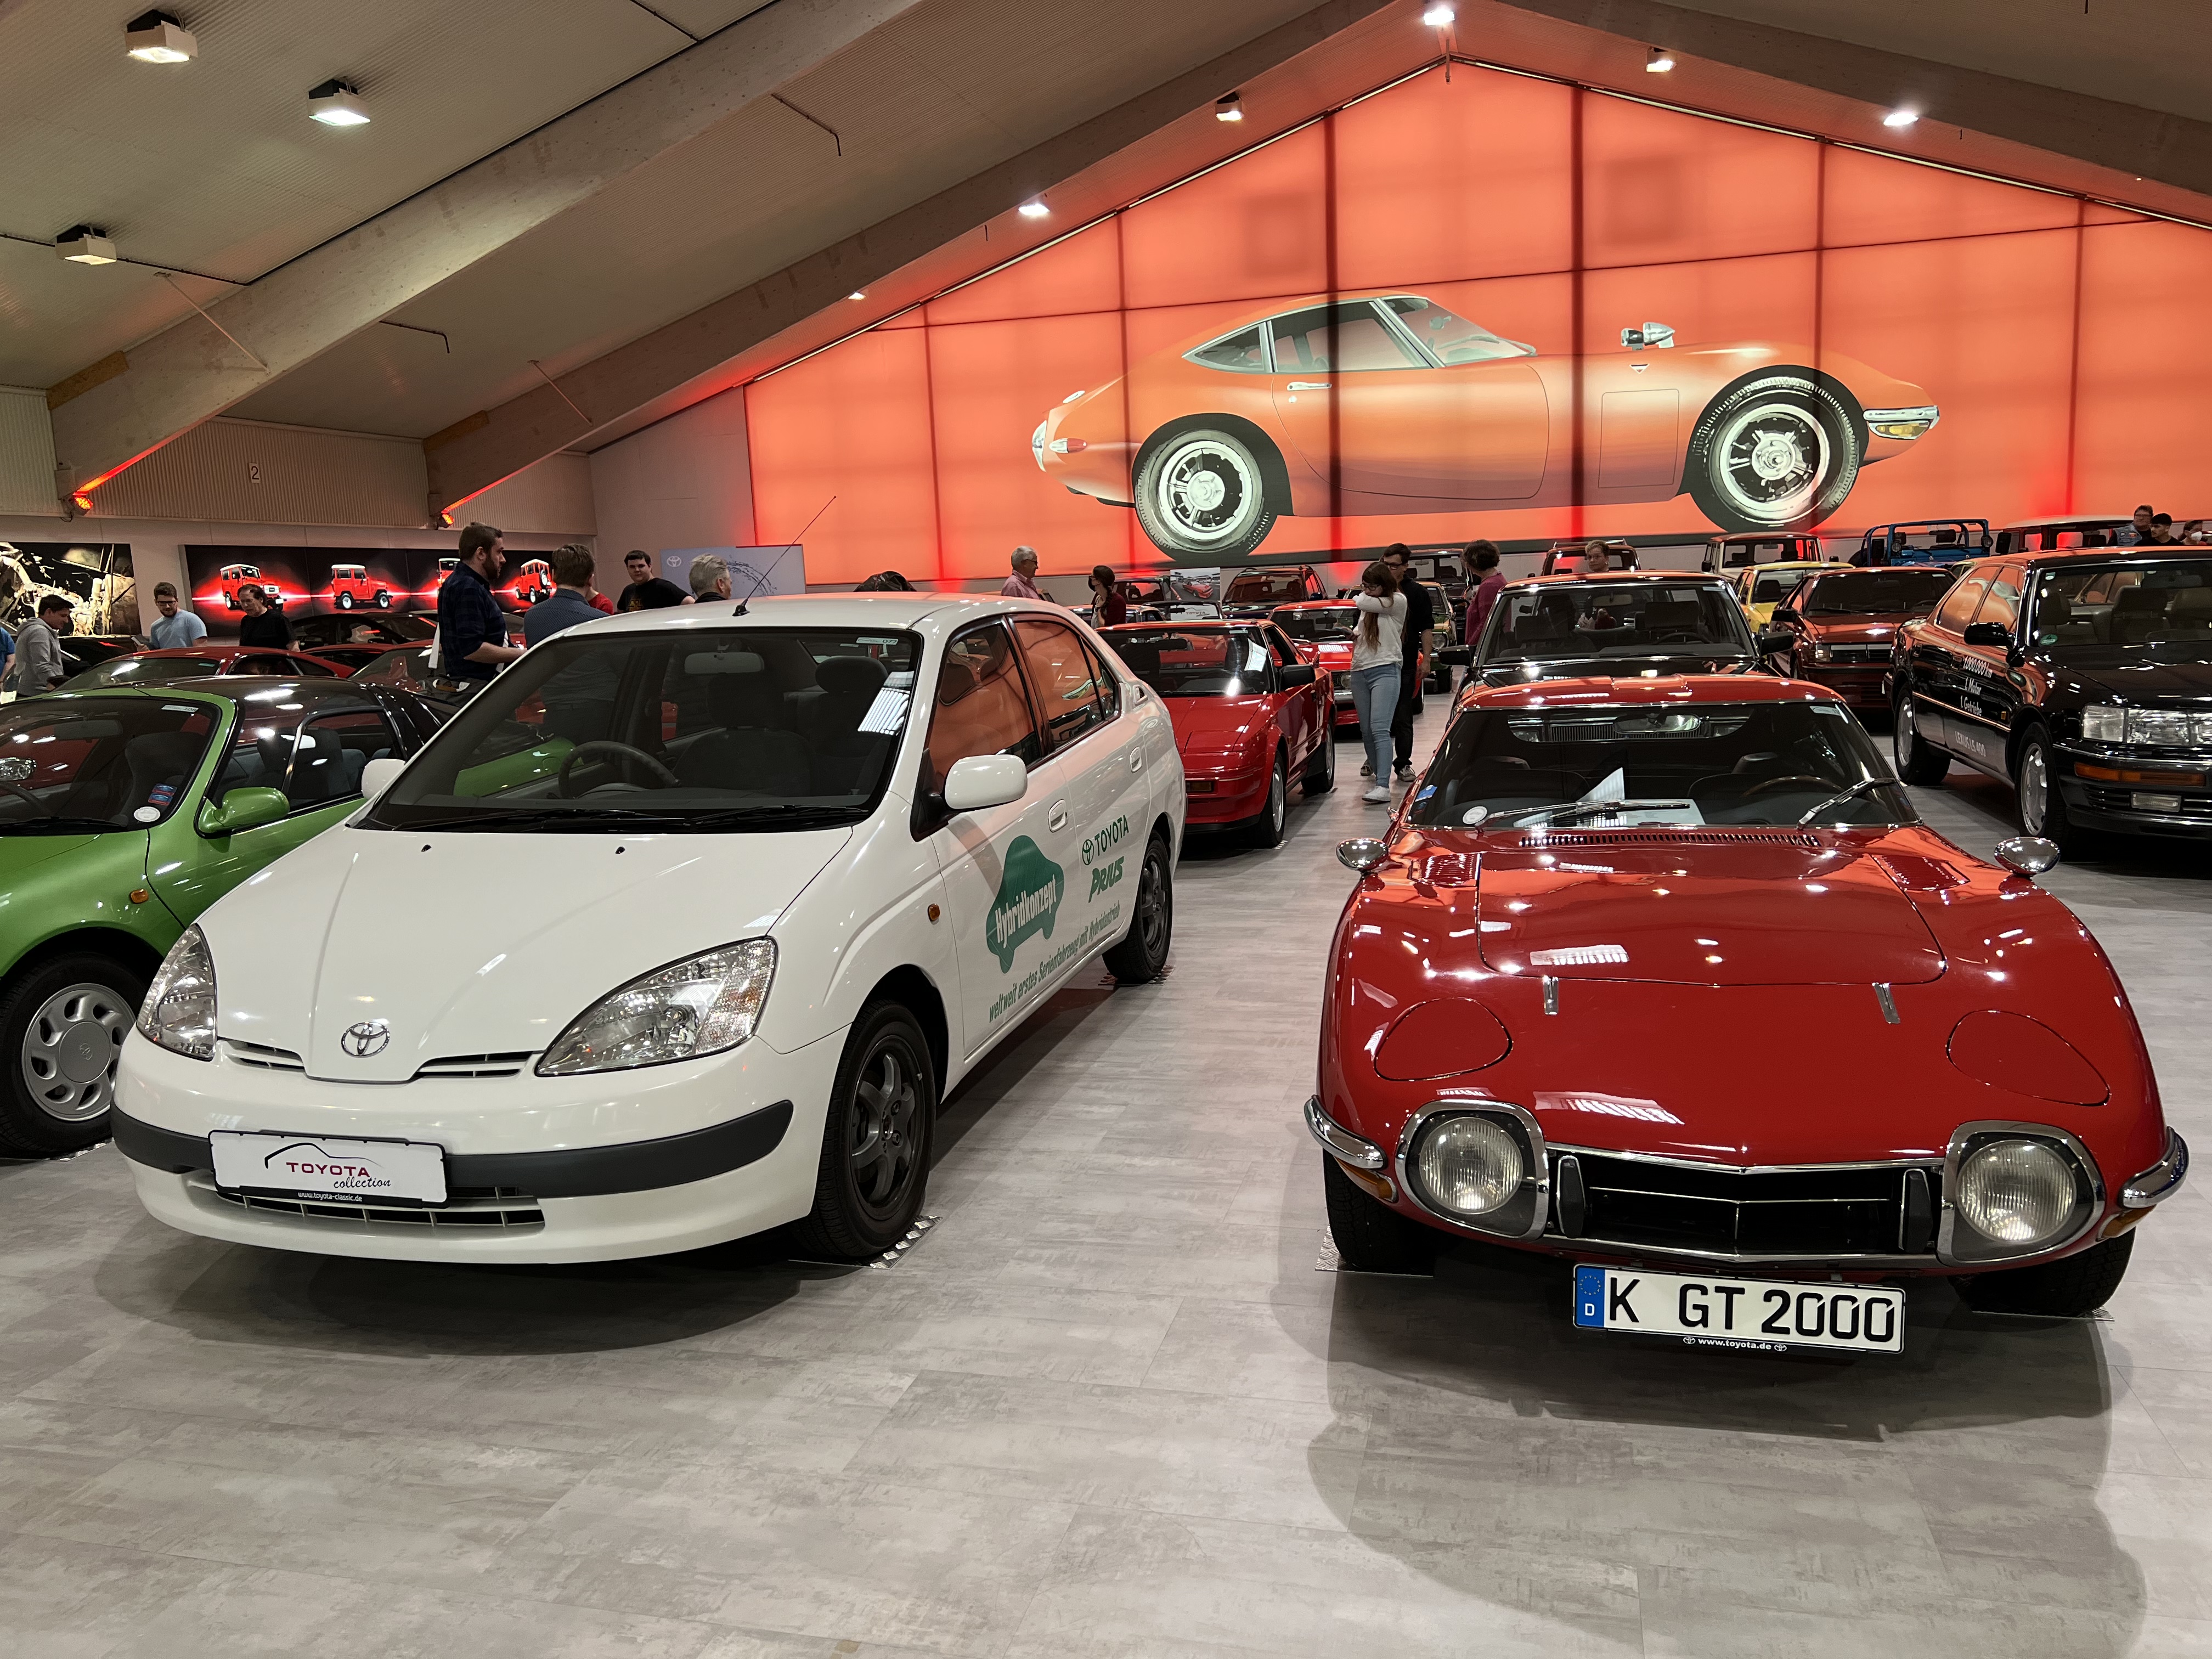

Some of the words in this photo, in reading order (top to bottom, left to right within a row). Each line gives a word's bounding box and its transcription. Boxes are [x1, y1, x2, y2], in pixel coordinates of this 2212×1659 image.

[251, 466, 259, 480] 2
[1984, 663, 1993, 678] km
[1968, 678, 1982, 696] Motor
[1963, 696, 1982, 716] Getriebe
[1955, 730, 1970, 750] LEXUS
[1976, 741, 1986, 757] 400
[1094, 814, 1130, 857] TOYOTA
[1088, 856, 1124, 904] PRIUS
[995, 873, 1057, 949] Hybridkonzept
[989, 983, 1017, 1023] weltweit
[1018, 970, 1038, 1000] erstes
[1038, 934, 1080, 983] Serienfahrzeug
[1079, 926, 1088, 949] mit
[1088, 900, 1120, 943] Hybridantrieb
[286, 1162, 370, 1178] TOYOTA
[333, 1176, 392, 1189] collection
[297, 1191, 363, 1202] www.toyota-classic.de
[1584, 1303, 1595, 1317] D
[1609, 1277, 1640, 1323] K
[1678, 1283, 1746, 1330] GT
[1760, 1288, 1895, 1342] 2000
[1698, 1338, 1772, 1350] www.toyota.de
